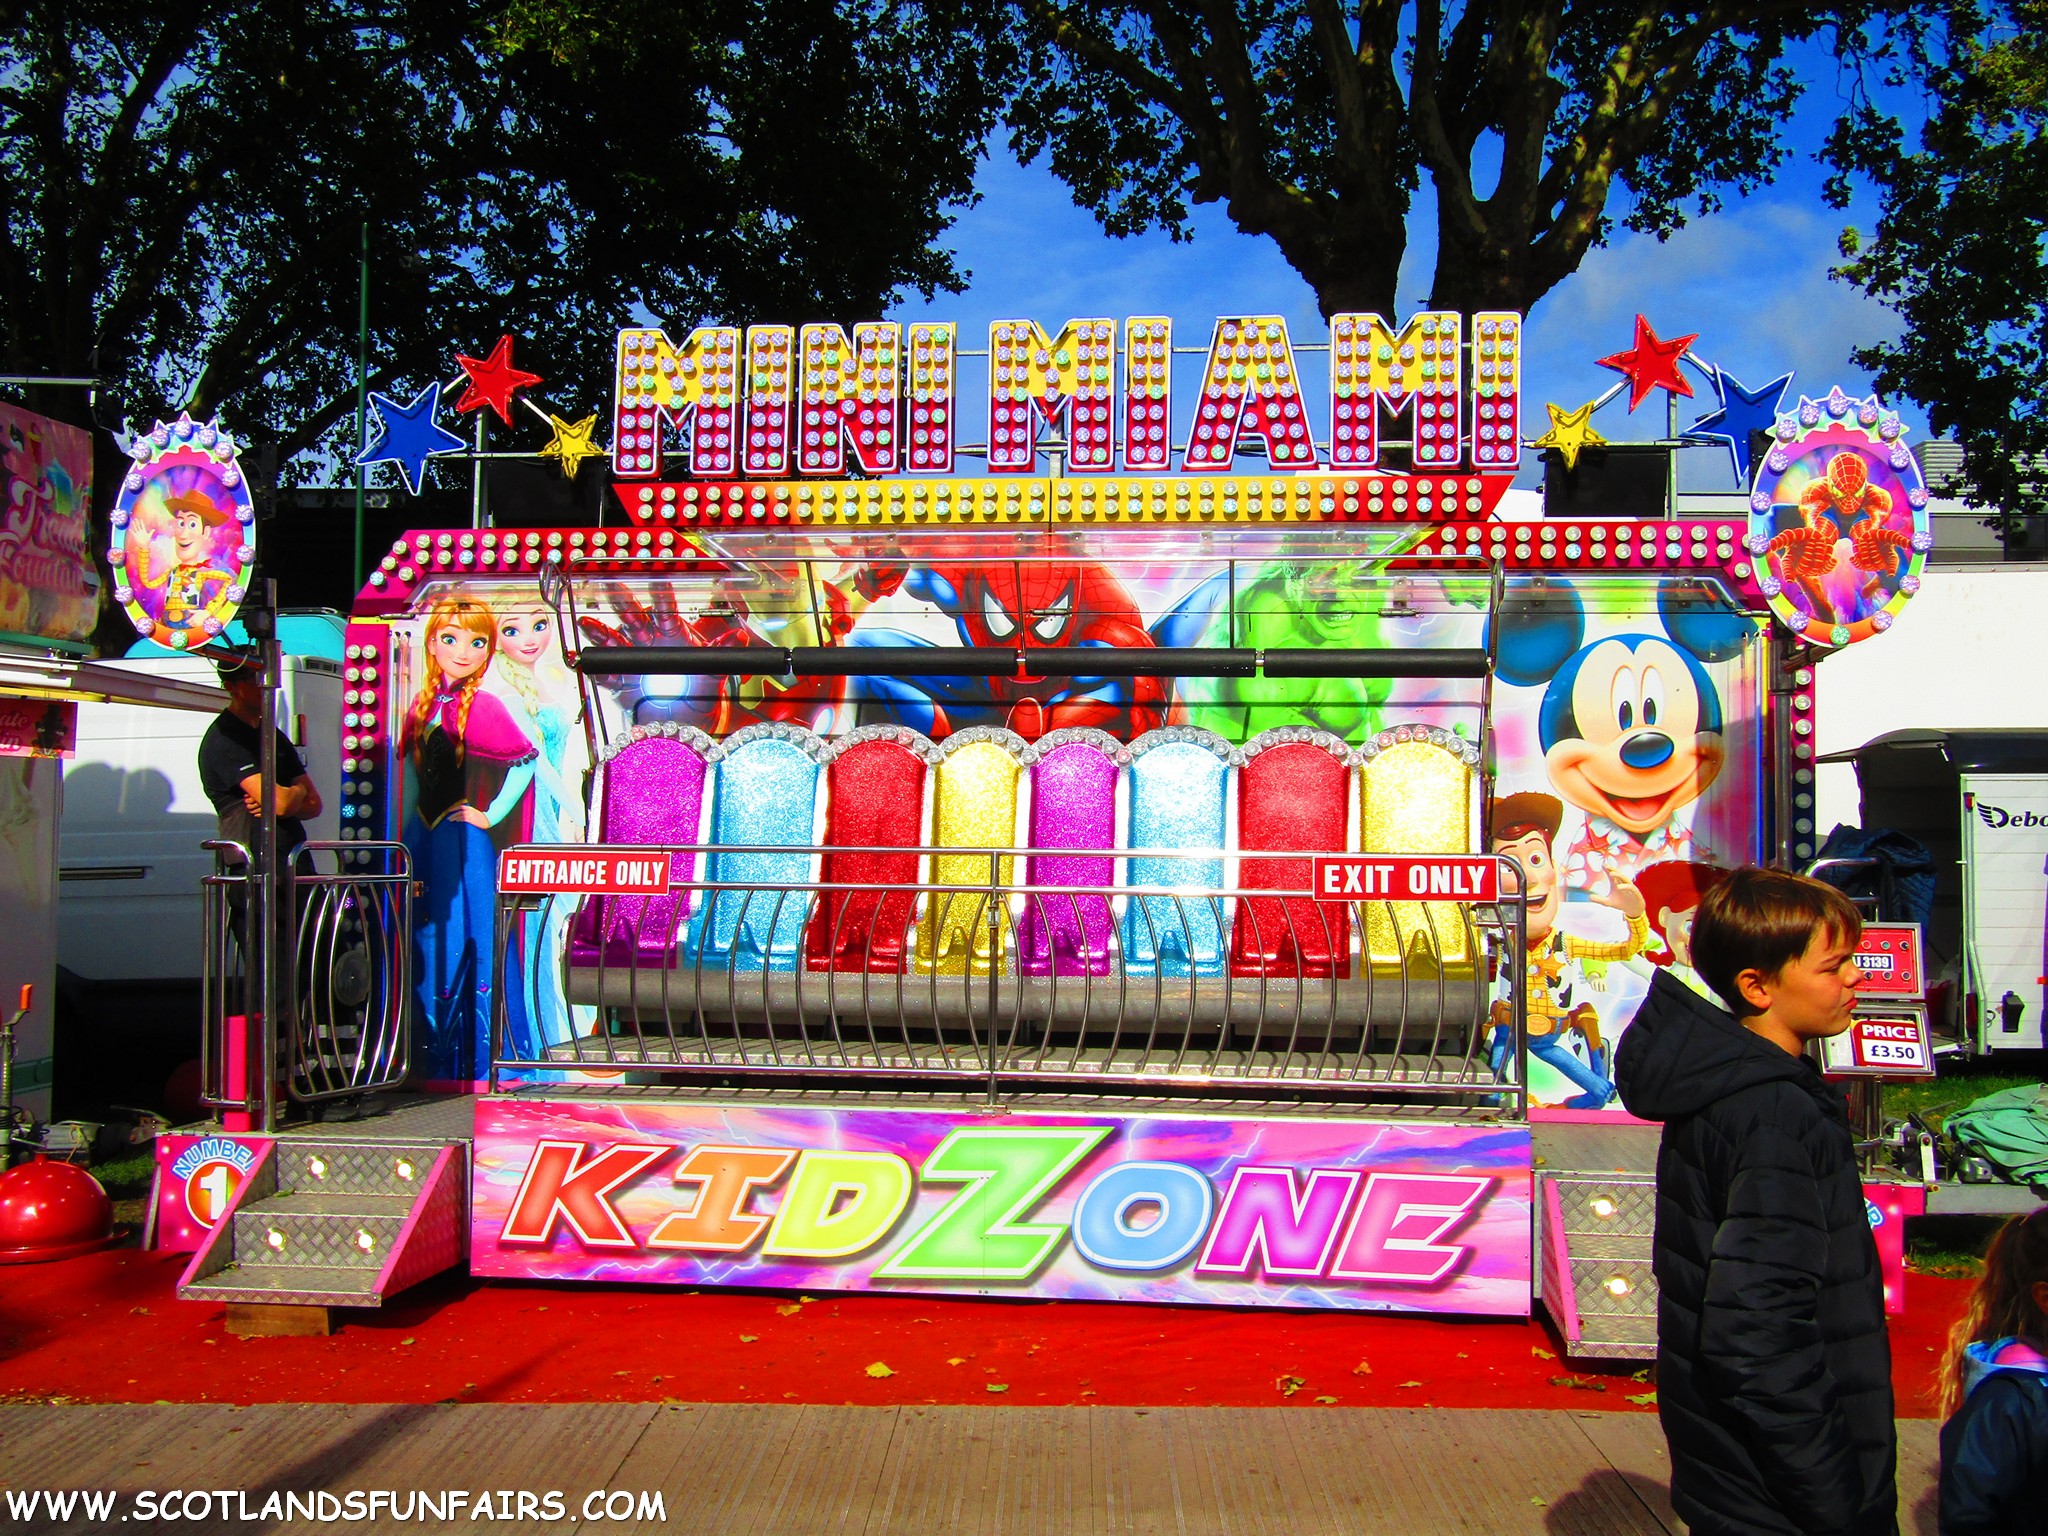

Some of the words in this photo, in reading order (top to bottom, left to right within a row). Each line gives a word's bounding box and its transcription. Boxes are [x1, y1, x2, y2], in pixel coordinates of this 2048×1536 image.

[613, 321, 957, 478] MINI
[986, 311, 1525, 474] MIAMI
[506, 859, 607, 885] ENTRANCE
[615, 860, 665, 886] ONLY
[1324, 864, 1395, 893] EXIT
[1408, 864, 1486, 894] ONLY
[1862, 956, 1889, 968] 3139
[1862, 1024, 1918, 1040] PRICE
[1871, 1044, 1915, 1060] £3.50
[171, 1138, 257, 1180] NUMBE
[200, 1166, 228, 1220] 1
[499, 1125, 1492, 1283] KIDZONE
